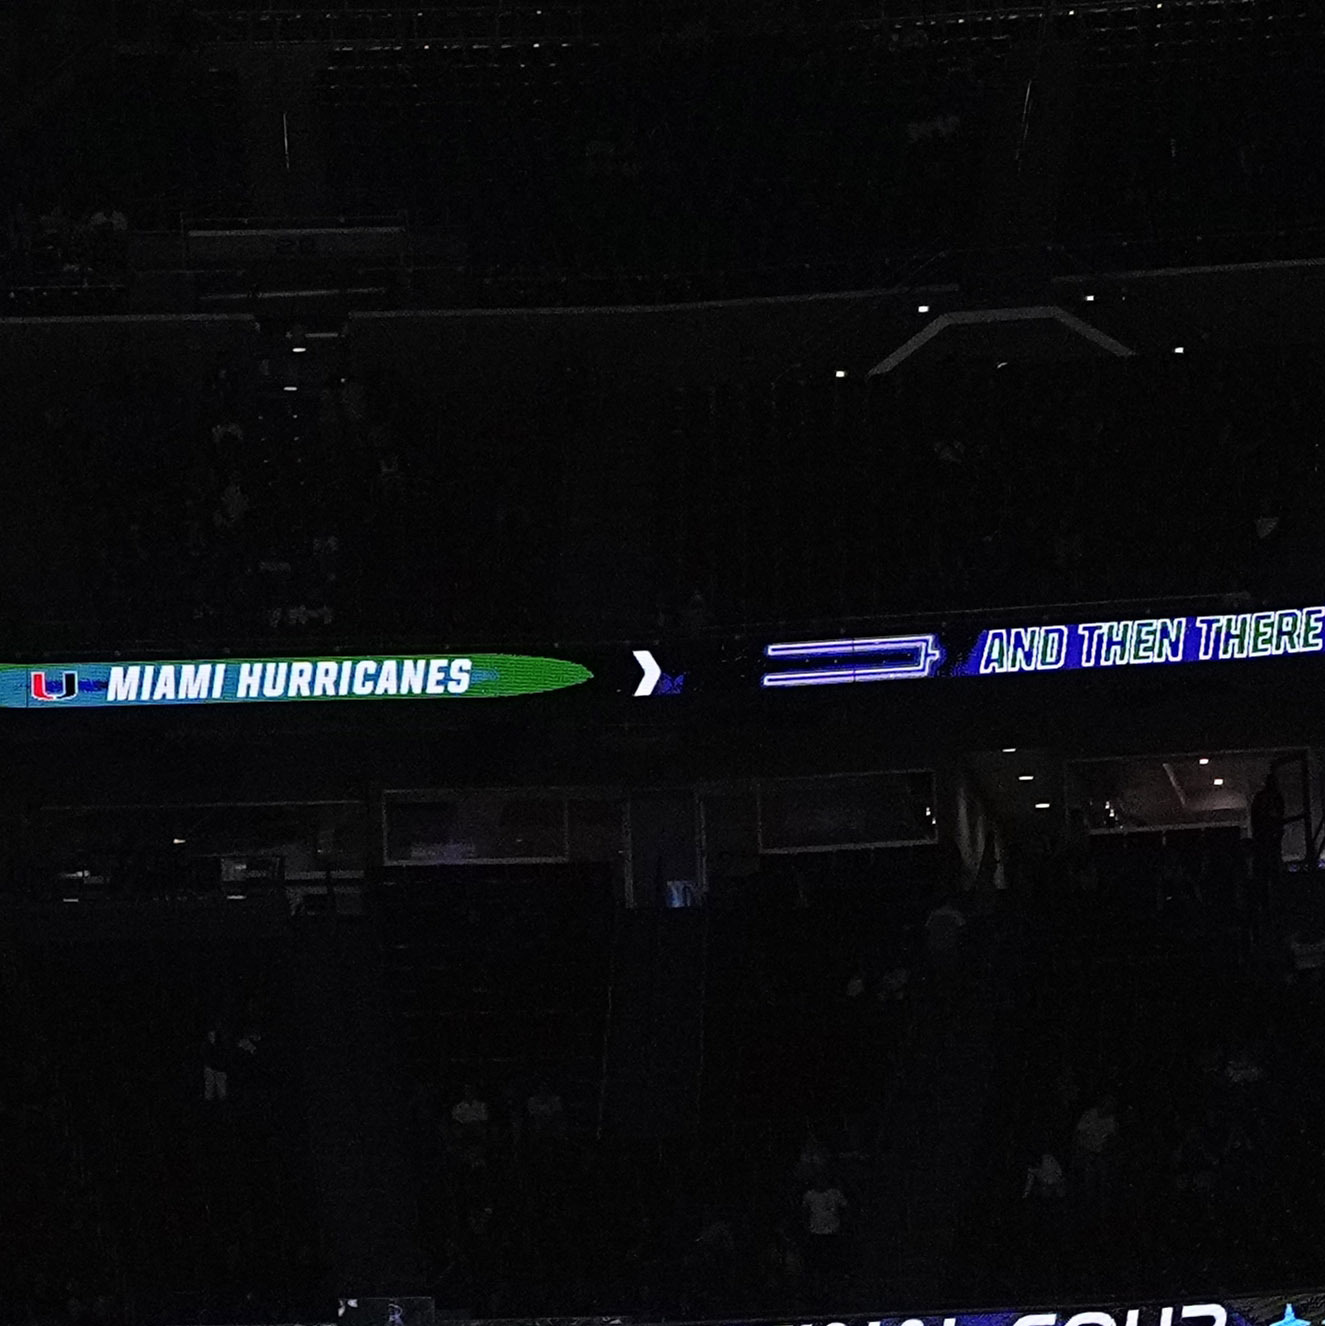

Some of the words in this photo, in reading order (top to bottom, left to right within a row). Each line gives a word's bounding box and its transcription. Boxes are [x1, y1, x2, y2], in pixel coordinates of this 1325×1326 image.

[980, 625, 1068, 673] AND
[1078, 618, 1187, 667] THEN
[1196, 607, 1325, 660] THERE
[107, 663, 226, 701] MIAMI
[237, 659, 473, 698] HURRICANES
